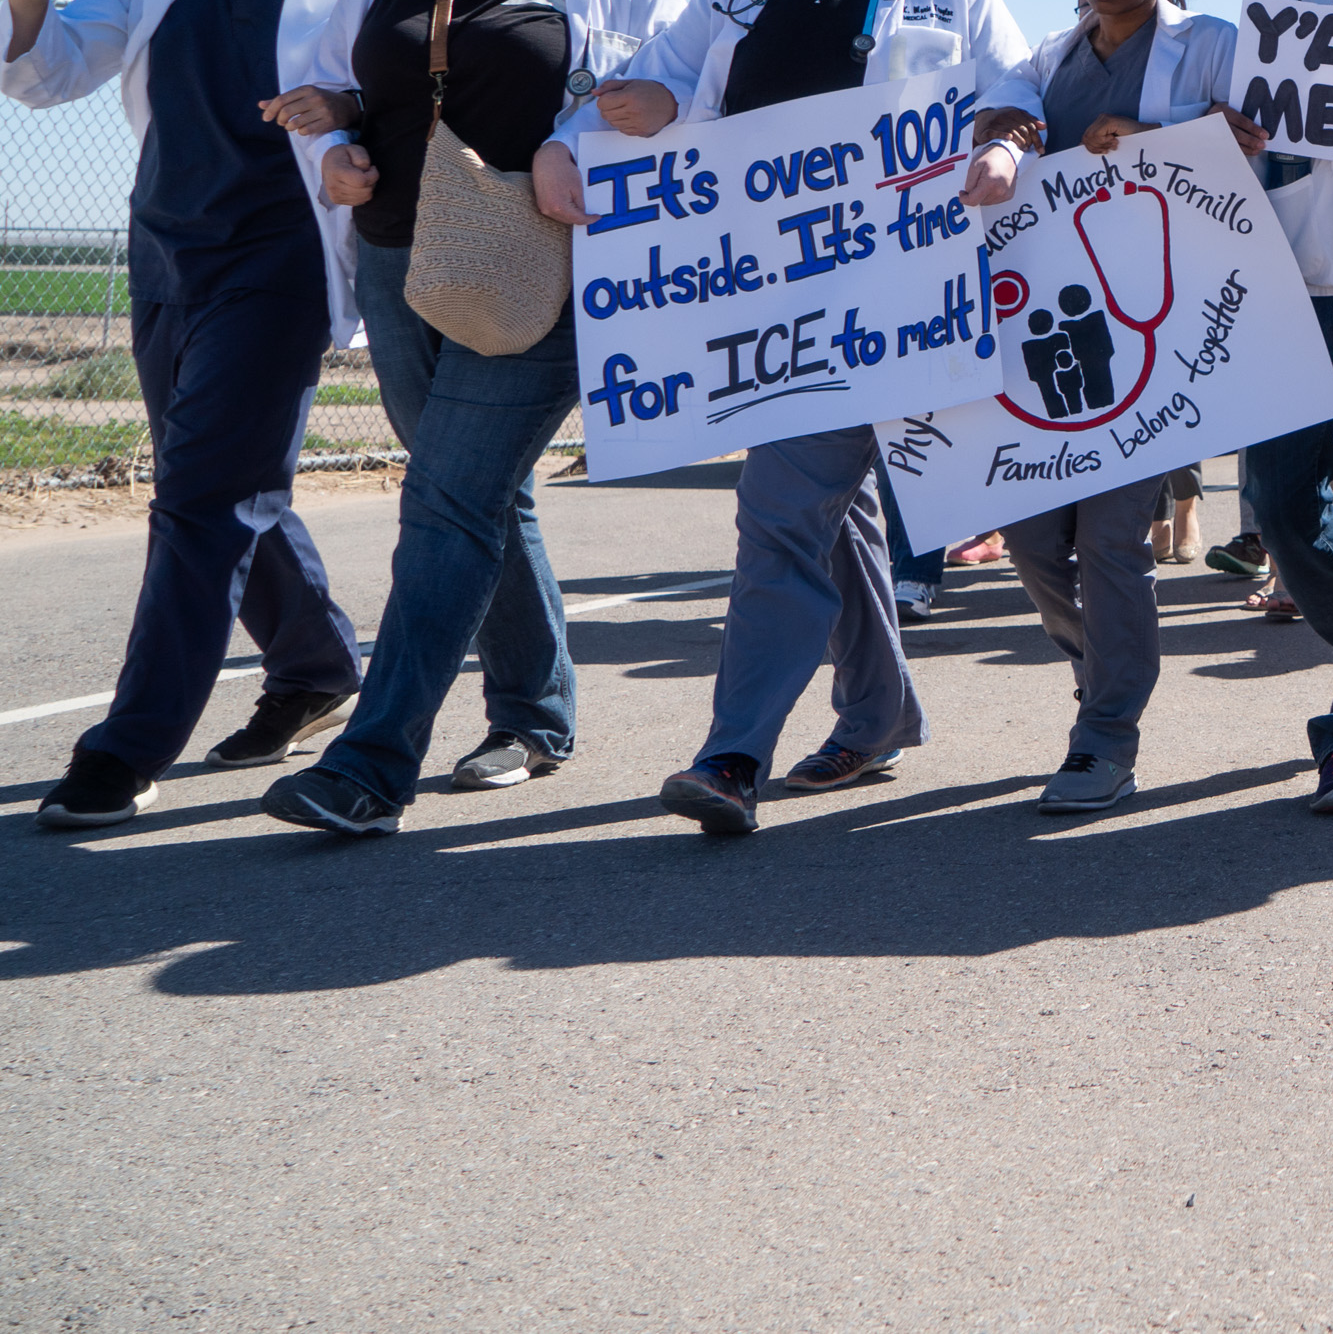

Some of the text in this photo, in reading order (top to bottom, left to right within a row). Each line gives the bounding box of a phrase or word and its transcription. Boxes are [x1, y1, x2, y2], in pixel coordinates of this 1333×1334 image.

[583, 188, 970, 320] outside. It's time
[588, 148, 719, 236] It's
[745, 142, 864, 202] over
[985, 203, 1039, 257] urses
[1041, 155, 1125, 212] March
[1131, 148, 1157, 181] to
[1163, 162, 1253, 234] Tornillo
[588, 353, 695, 427] for
[831, 307, 886, 369] to
[897, 244, 996, 360] melt!
[985, 269, 1249, 487] Families belong together
